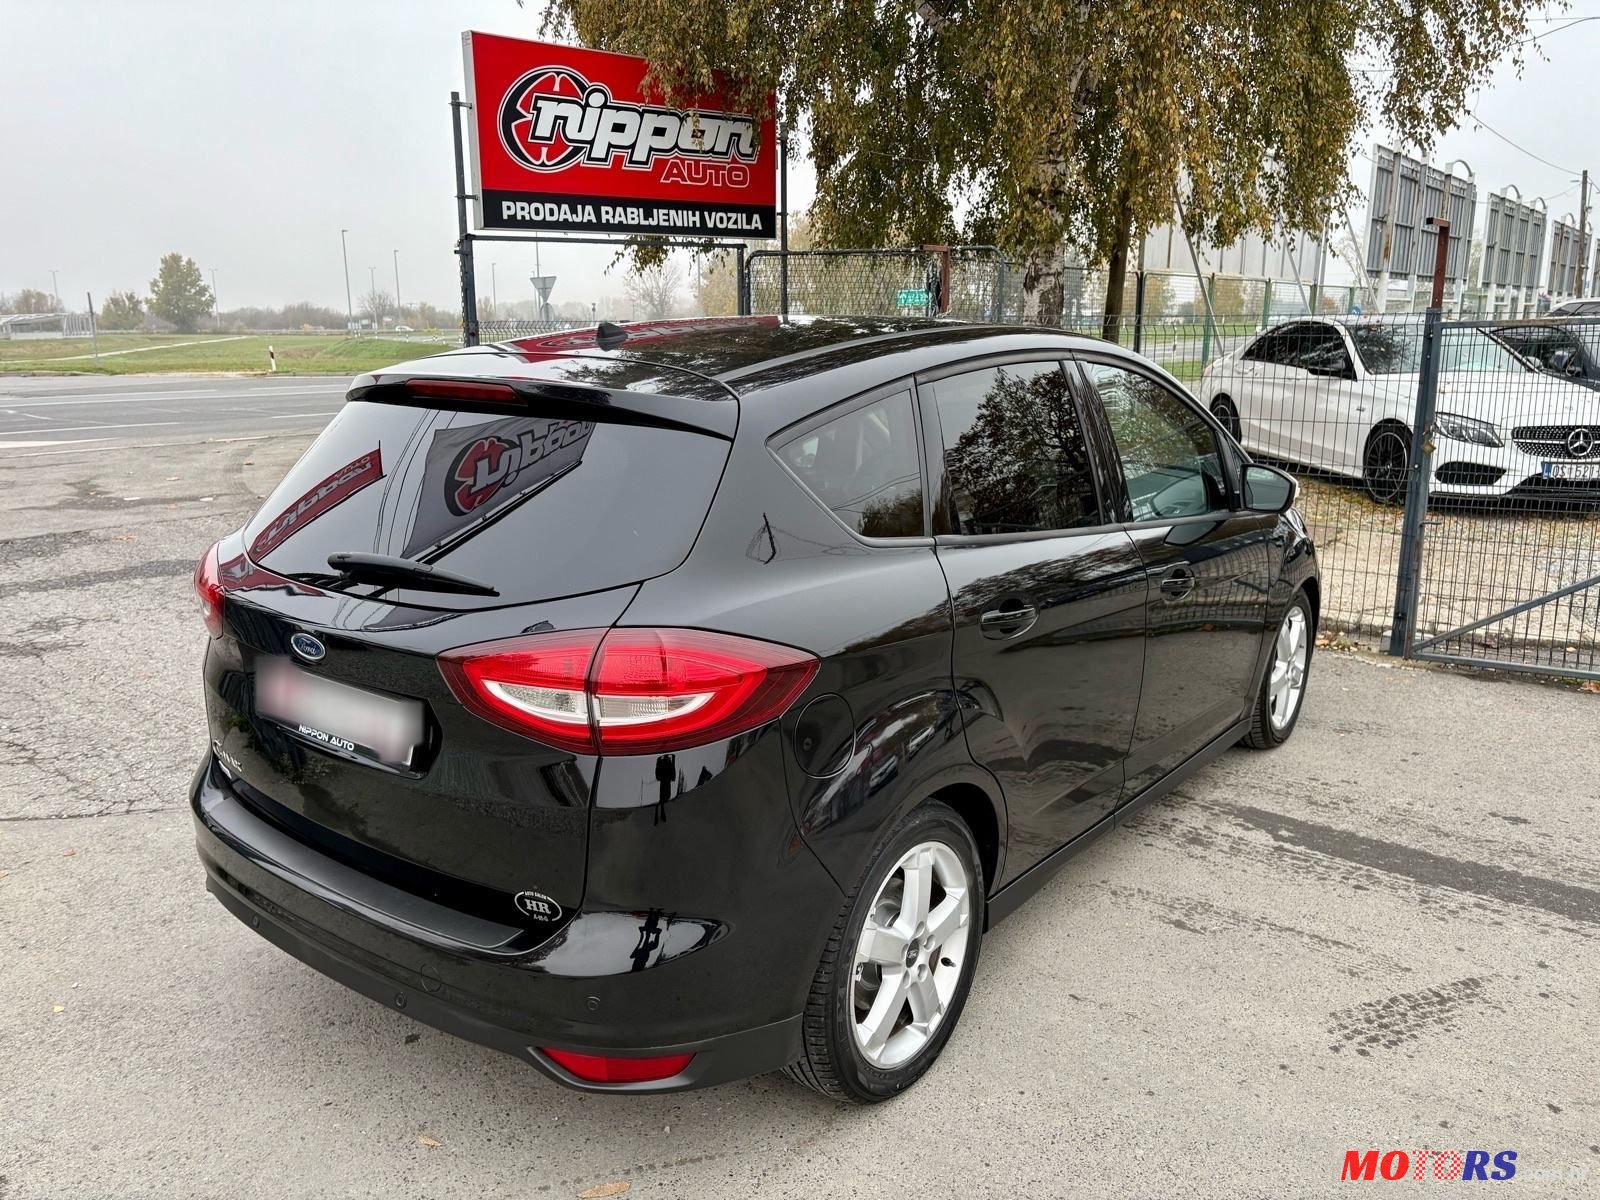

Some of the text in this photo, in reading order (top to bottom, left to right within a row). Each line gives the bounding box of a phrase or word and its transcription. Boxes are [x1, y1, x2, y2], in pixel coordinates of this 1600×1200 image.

[531, 85, 757, 164] nippon
[660, 160, 749, 188] AUTO
[501, 200, 763, 231] PRODAJA RABLJENIH VOZILA
[298, 723, 355, 751] NIPPON AUTO
[524, 898, 552, 915] HR
